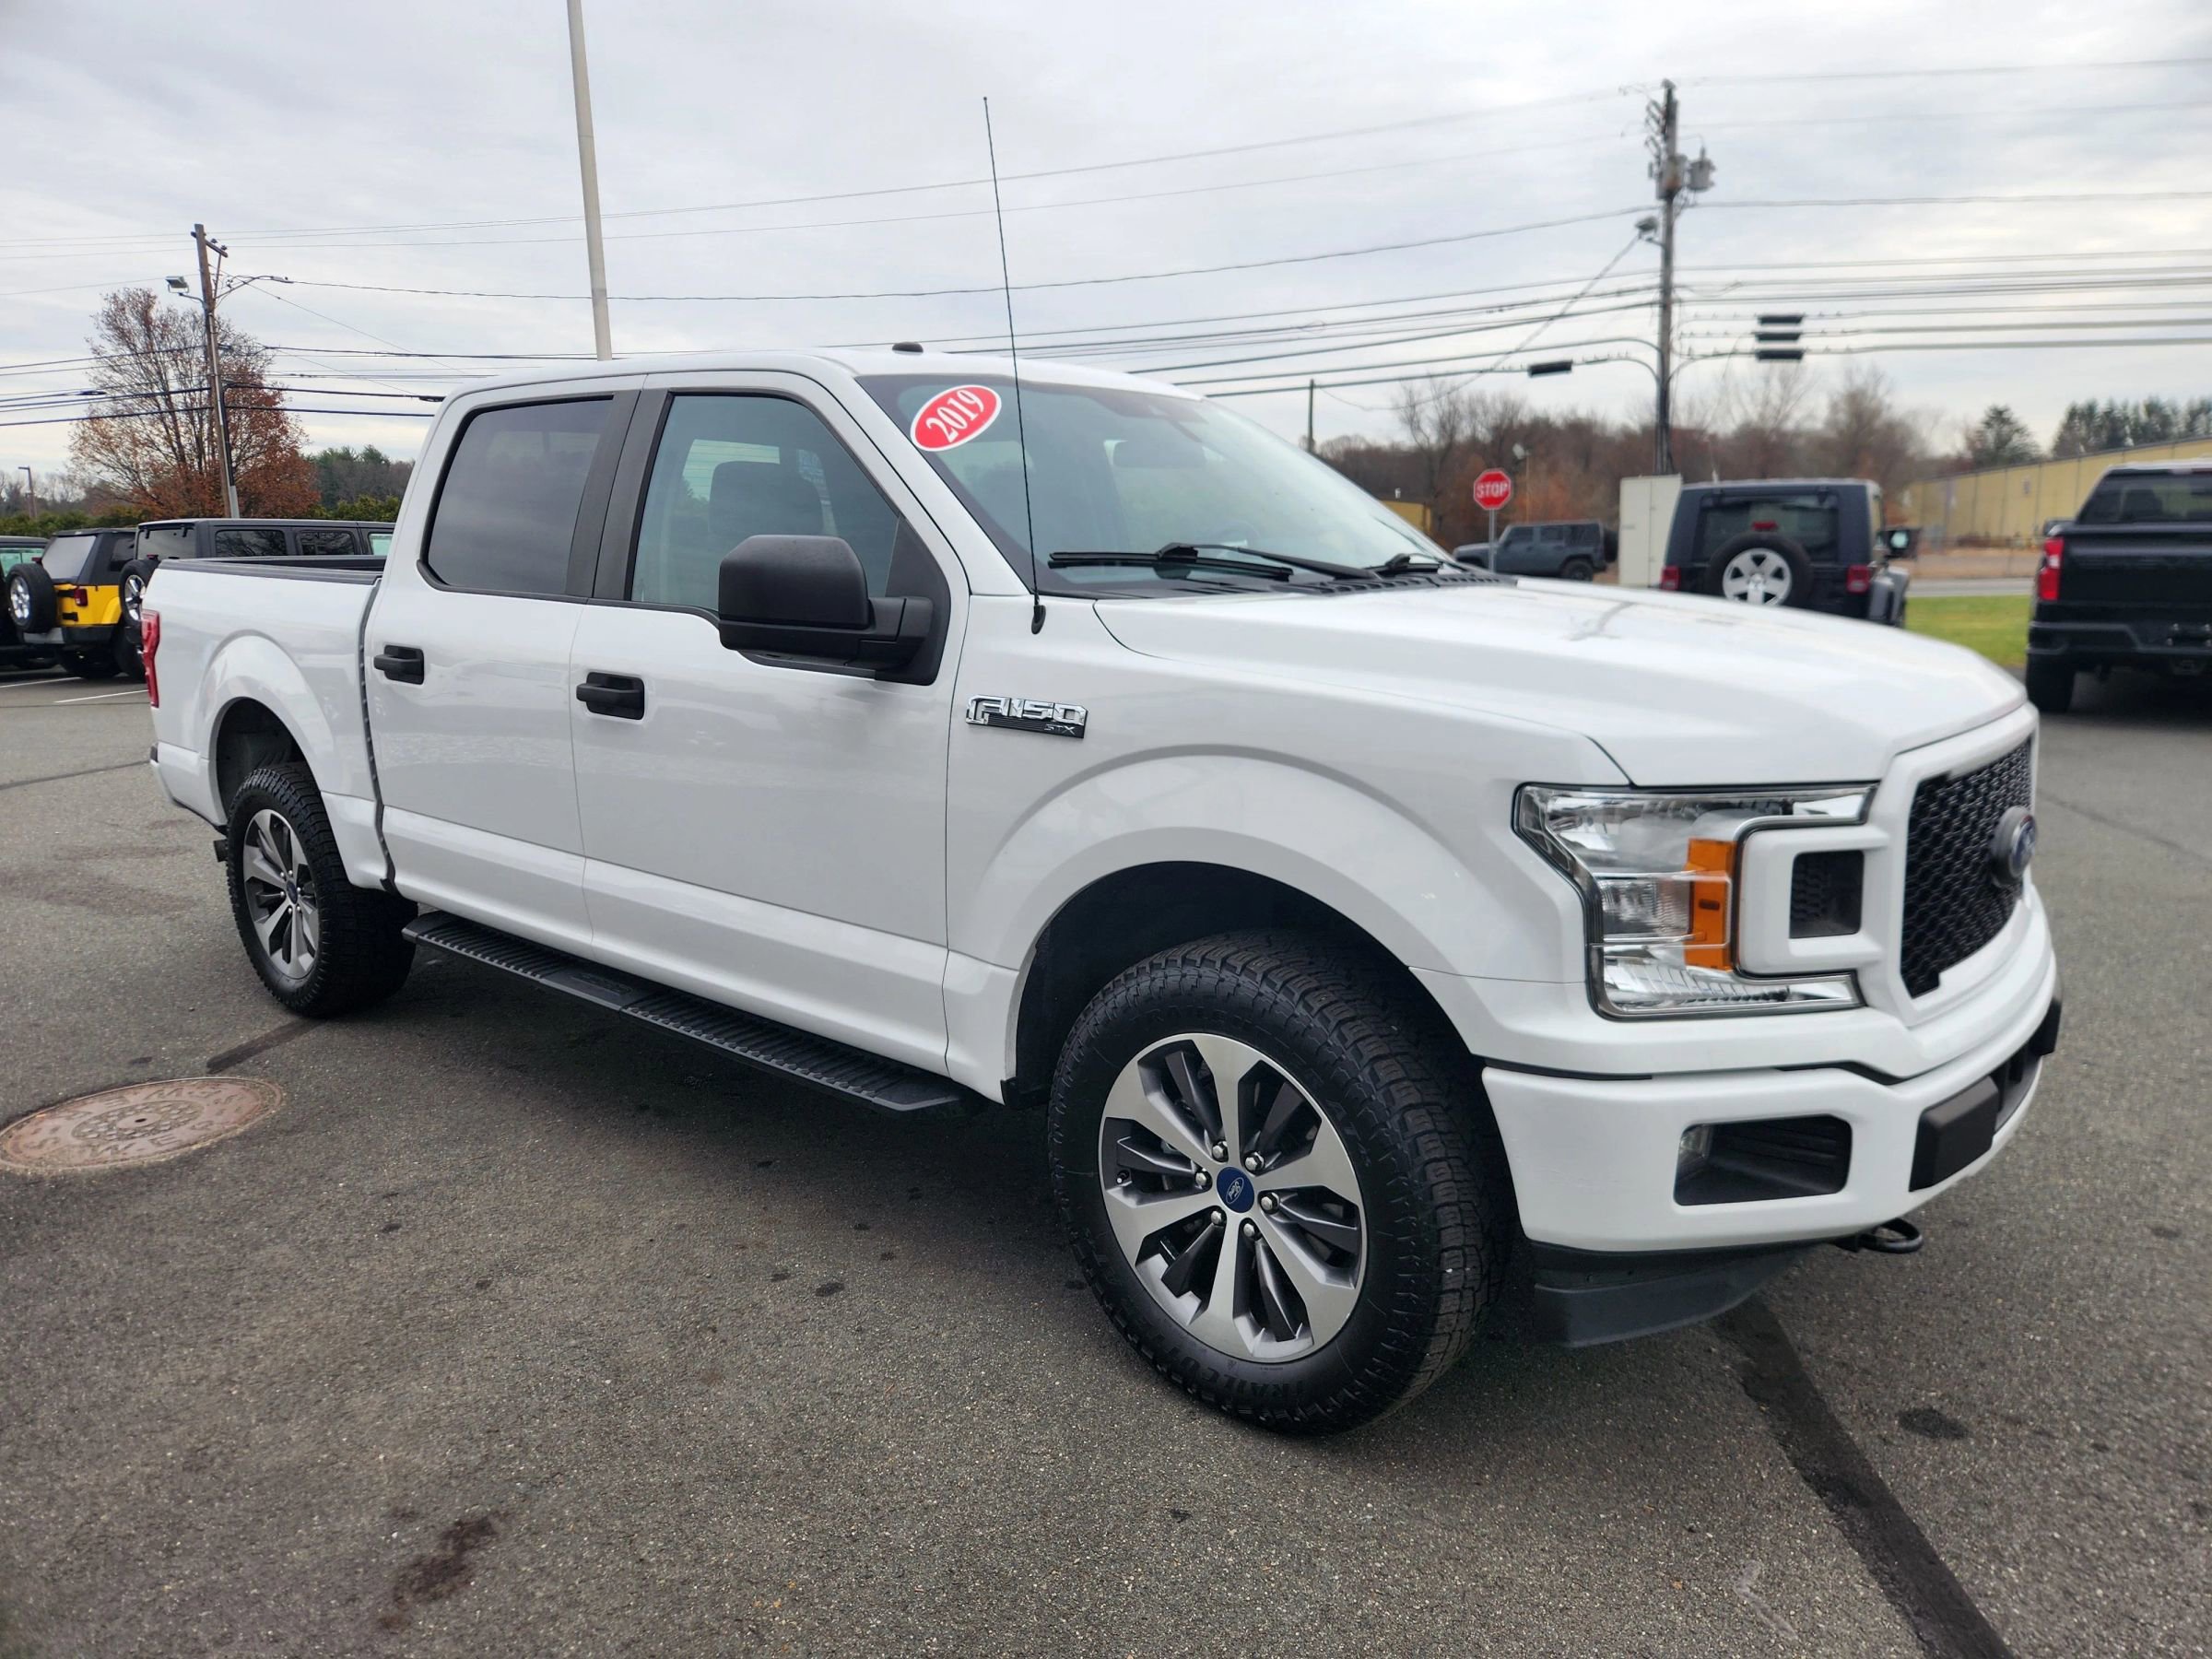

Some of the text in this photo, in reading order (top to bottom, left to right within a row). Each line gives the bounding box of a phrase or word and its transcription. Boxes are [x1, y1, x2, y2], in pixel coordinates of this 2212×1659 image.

[925, 389, 984, 442] 2019
[1477, 481, 1509, 499] STOP
[1043, 724, 1077, 735] STX
